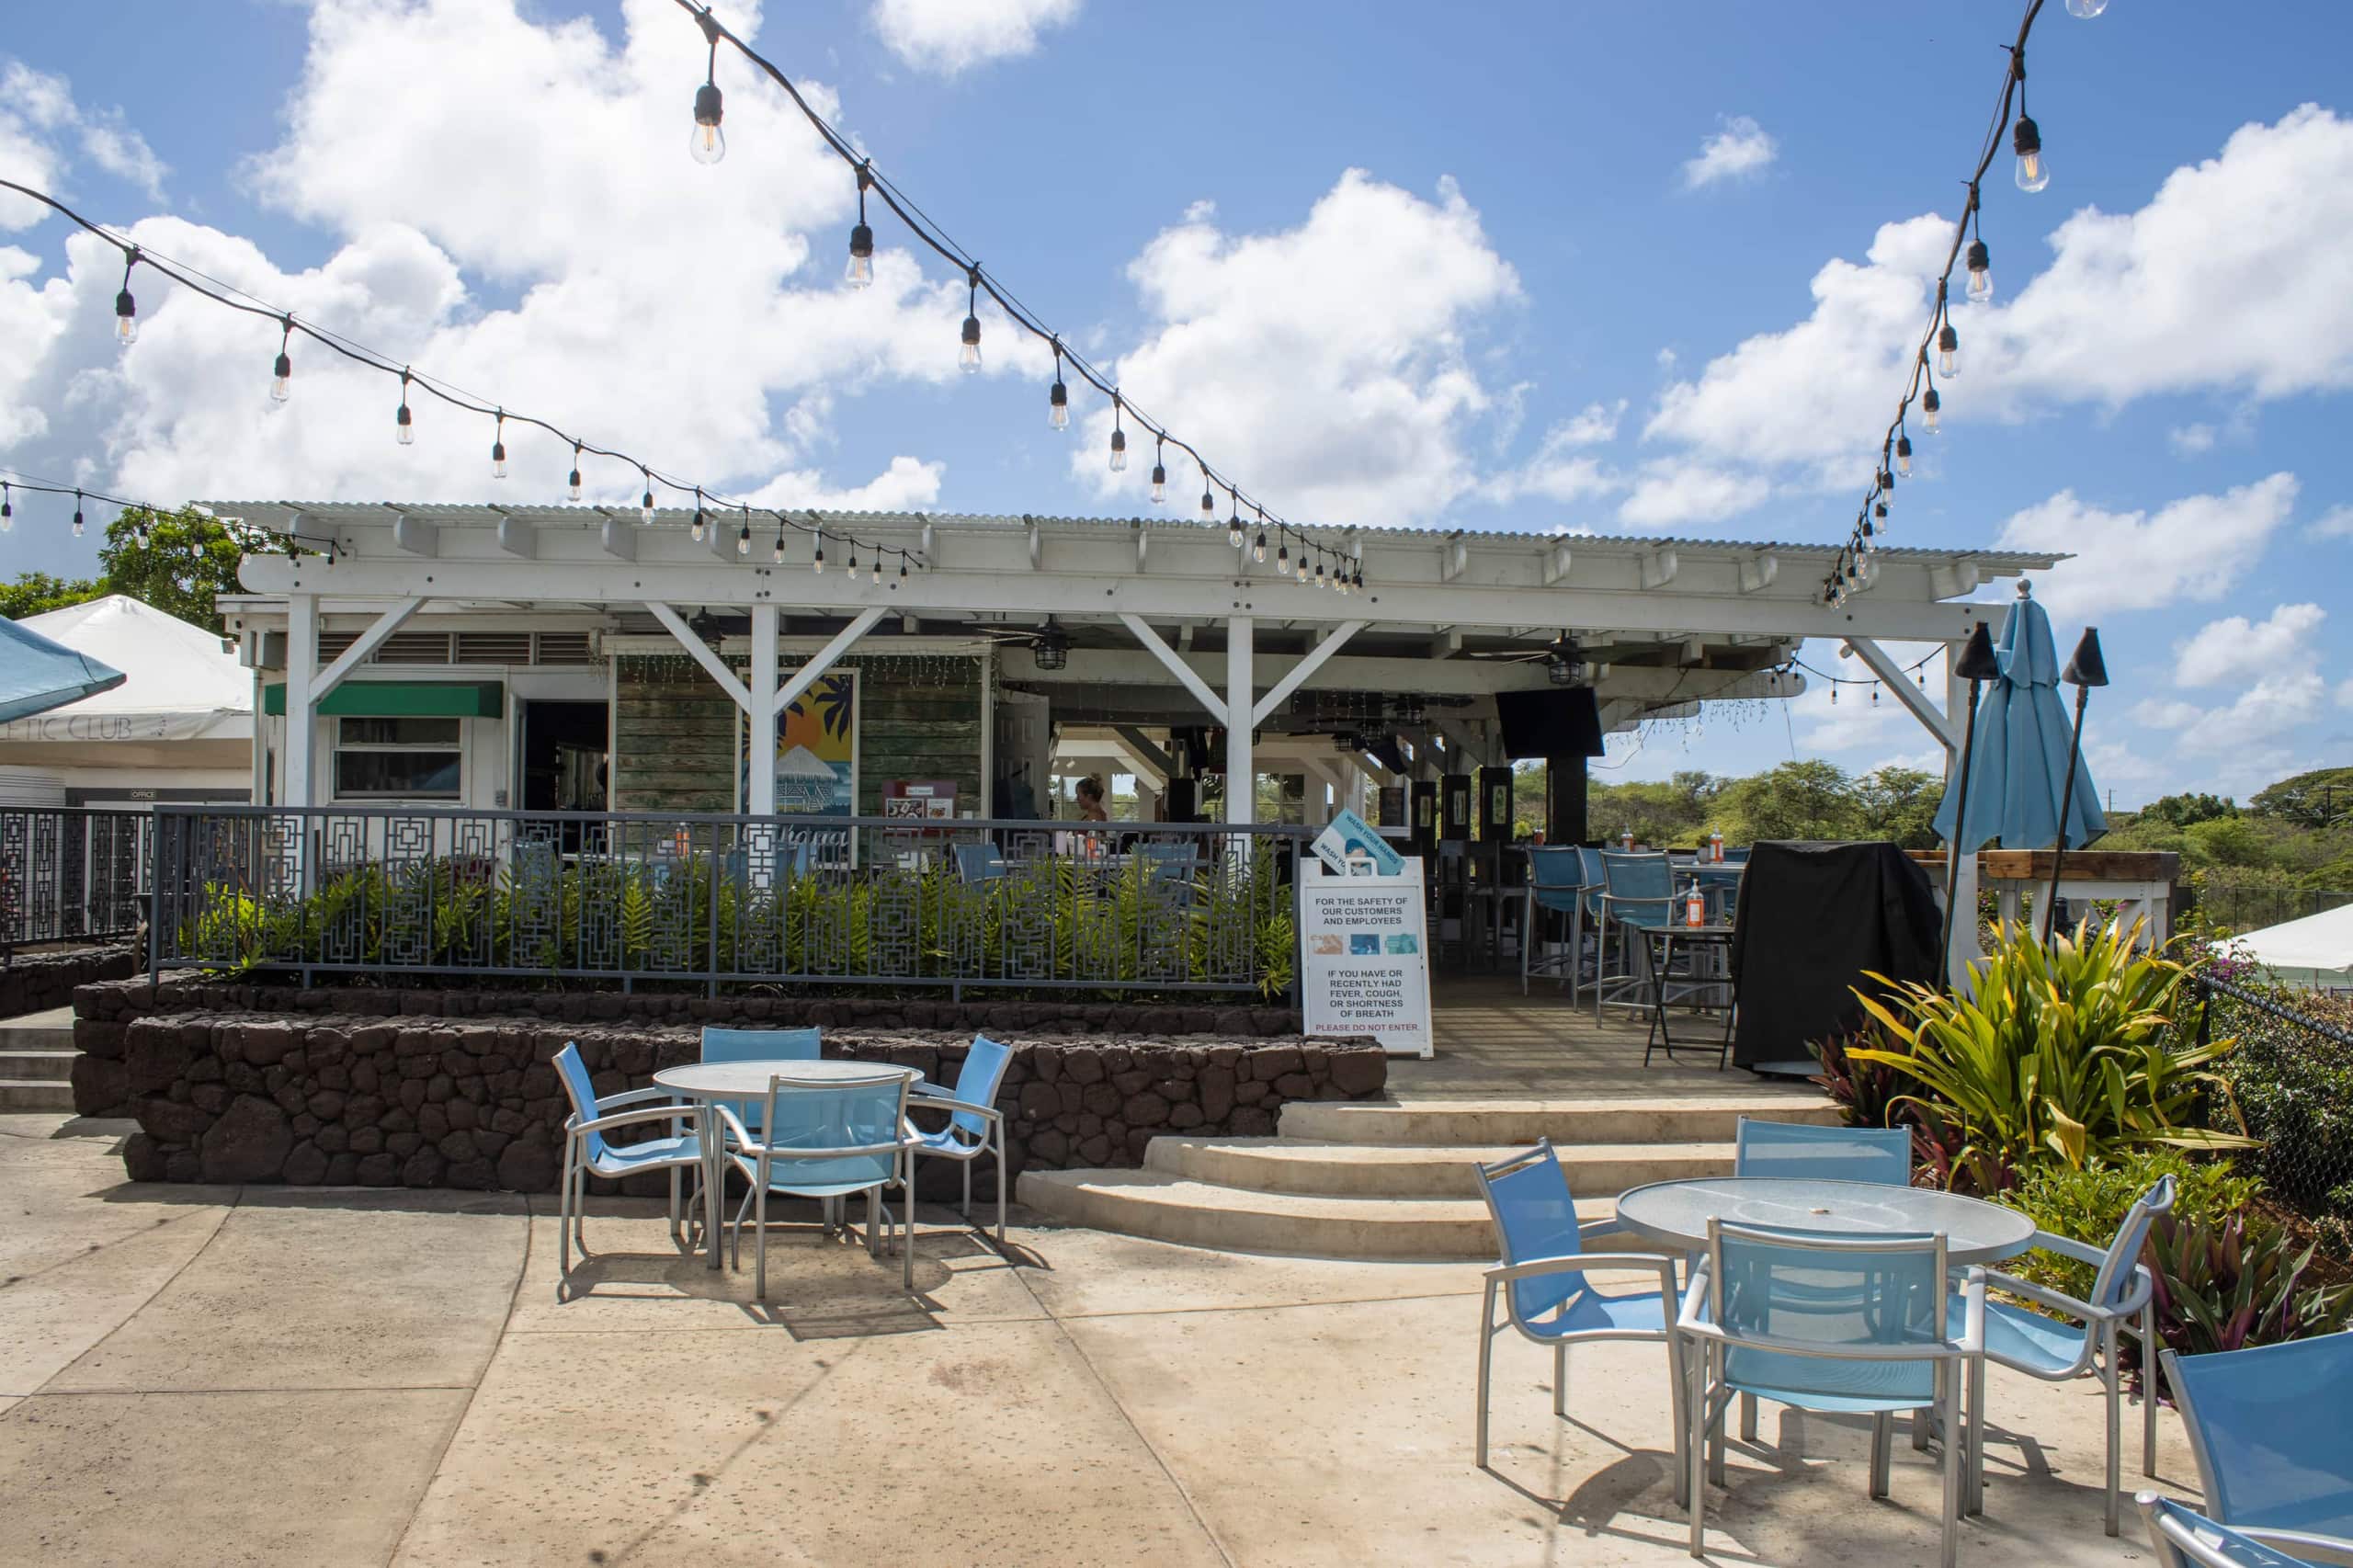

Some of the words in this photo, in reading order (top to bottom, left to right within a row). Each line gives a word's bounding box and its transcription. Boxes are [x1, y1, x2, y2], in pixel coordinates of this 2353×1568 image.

[0, 718, 58, 741] ETIC
[68, 714, 132, 740] CLUB
[1346, 814, 1363, 833] WASH
[1363, 831, 1379, 847] YOUR
[1379, 844, 1398, 865] HANDS
[1321, 843, 1339, 861] WASH
[1315, 897, 1335, 905] FOR
[1337, 897, 1355, 905] THE
[1358, 897, 1392, 905] SAFETY
[1395, 897, 1408, 905] OF
[1322, 907, 1342, 915] OUR
[1345, 906, 1403, 915] CUSTOMERS
[1324, 917, 1343, 926] AND
[1346, 916, 1402, 926] EMPLOYEES
[1328, 970, 1336, 978] IF
[1338, 970, 1358, 978] YOU
[1360, 970, 1386, 978] HAVE
[1389, 970, 1403, 978] OR
[1330, 980, 1379, 988] RECENTLY
[1381, 979, 1402, 988] HAD
[1330, 990, 1363, 999] FEVER,
[1365, 990, 1402, 998] COUGH,
[1329, 1000, 1345, 1008] OR
[1346, 999, 1404, 1008] SHORTNESS
[1339, 1010, 1353, 1018] OF
[1355, 1010, 1394, 1018] BREATH
[1315, 1024, 1351, 1032] PLEASE
[1352, 1024, 1367, 1032] DO
